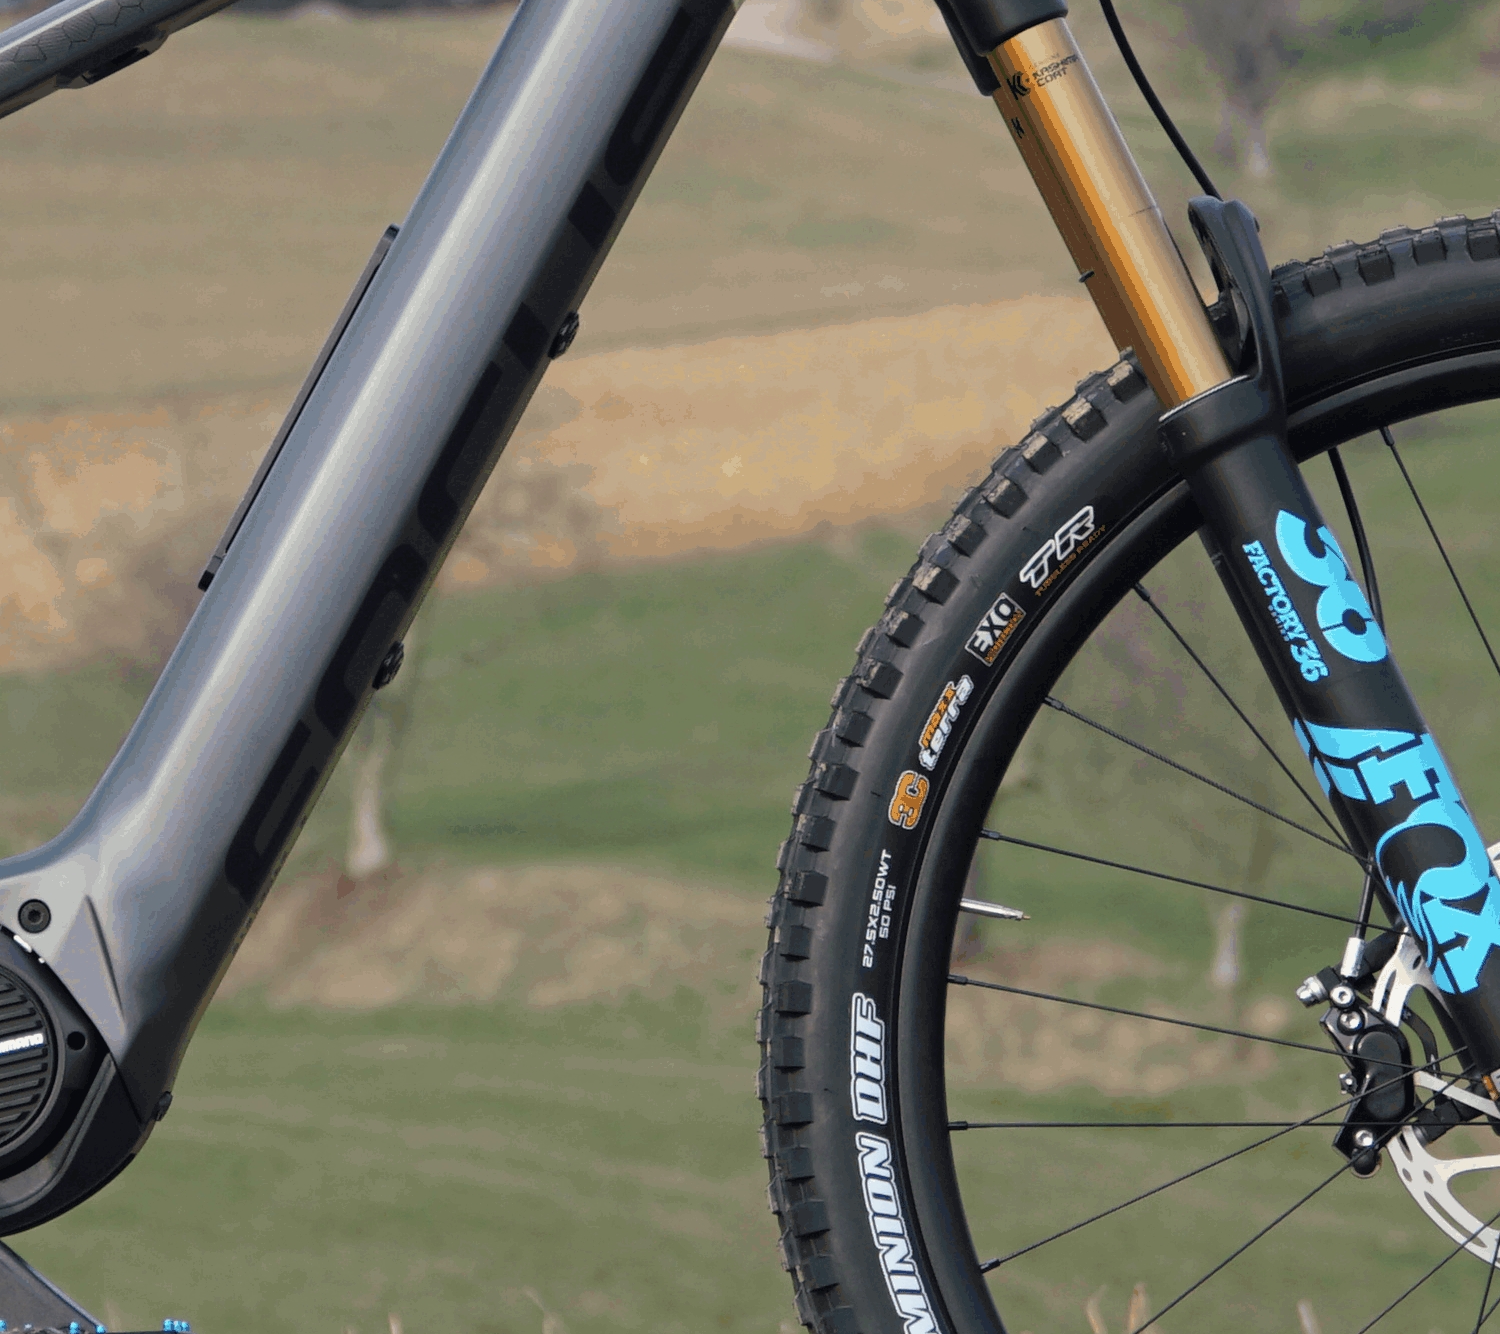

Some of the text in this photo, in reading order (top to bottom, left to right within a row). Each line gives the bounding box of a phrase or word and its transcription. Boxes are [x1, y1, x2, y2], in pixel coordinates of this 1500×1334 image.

[1020, 505, 1095, 588] TR
[966, 598, 1016, 656] EXO
[1242, 540, 1310, 641] FACTORY
[1289, 639, 1329, 683] 36
[888, 770, 930, 830] 3C
[862, 848, 892, 968] 27.5X2.50WT
[879, 884, 897, 939] 50 PSI
[850, 992, 889, 1126] DHF
